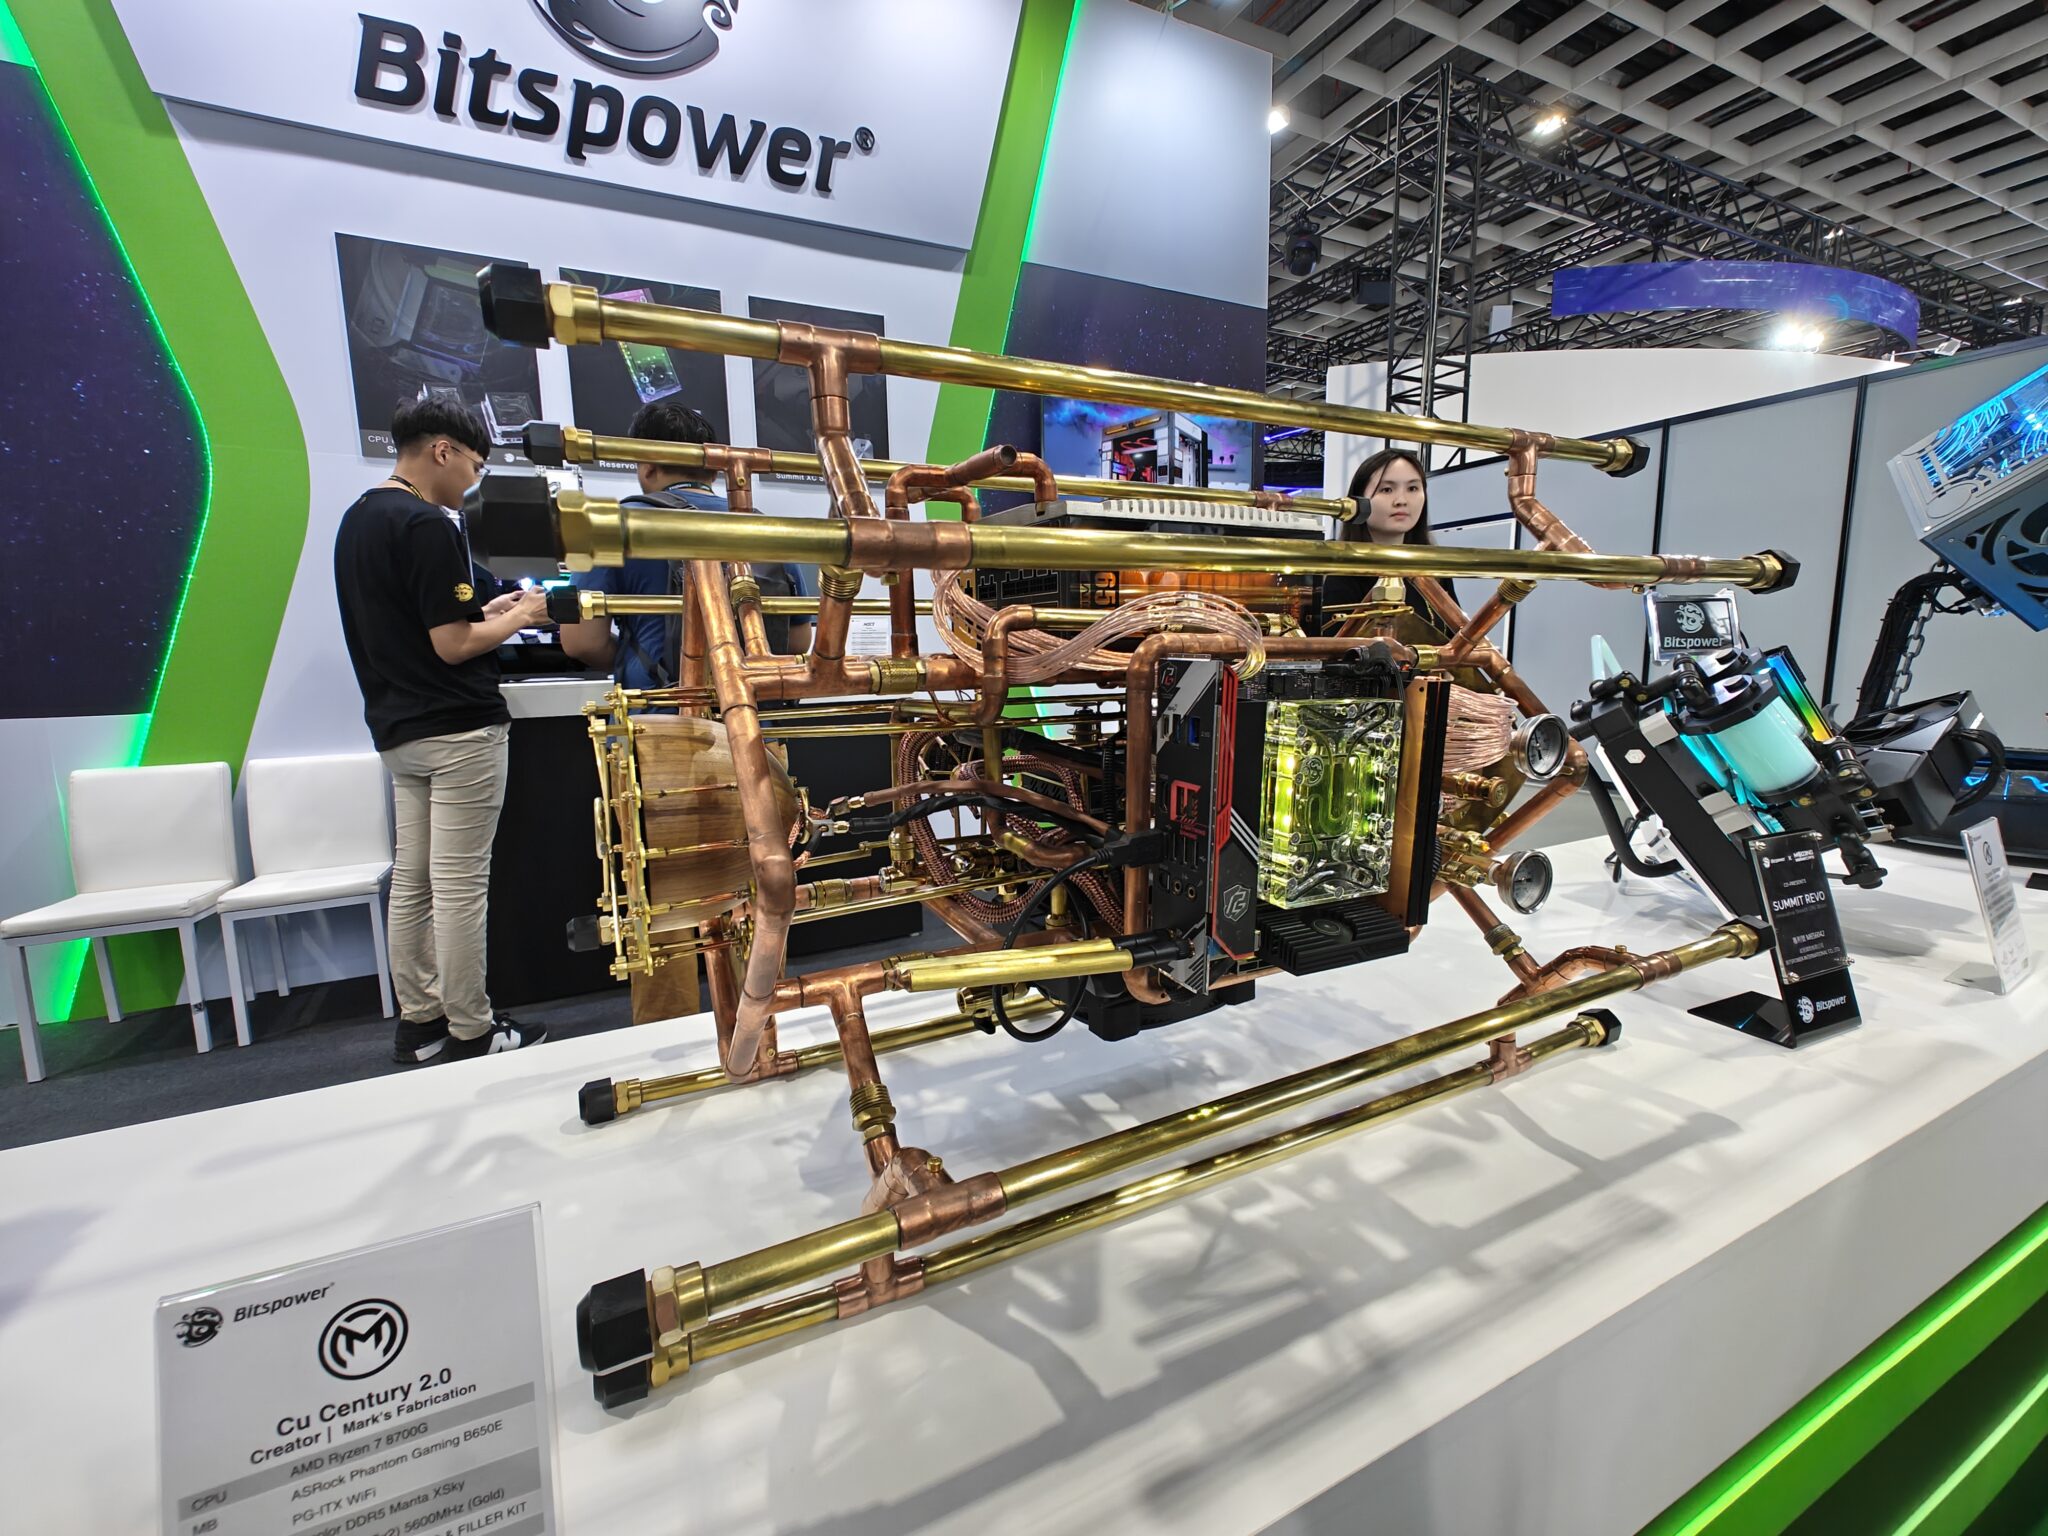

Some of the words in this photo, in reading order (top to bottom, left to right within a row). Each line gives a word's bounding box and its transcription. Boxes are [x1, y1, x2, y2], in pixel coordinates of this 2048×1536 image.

[368, 435, 389, 444] CPU
[1663, 636, 1723, 650] Bitspower
[1772, 895, 1804, 912] SUMMIT
[1804, 890, 1826, 905] REVO
[1815, 995, 1847, 1012] Bitspower
[233, 1285, 331, 1323] Bitspower
[276, 1414, 311, 1437] Cu
[319, 1382, 412, 1423] Century
[418, 1367, 452, 1392] 2.0
[250, 1432, 322, 1465] Creator
[342, 1411, 392, 1435] Mark's
[396, 1383, 477, 1417] Fabrication
[191, 1490, 228, 1513] CPU
[290, 1457, 325, 1478] AMD
[328, 1442, 371, 1468] Ryzen
[374, 1436, 383, 1450] 7
[386, 1422, 429, 1446] 8700G
[192, 1518, 219, 1536] MB
[291, 1474, 346, 1502] ASRock
[350, 1453, 408, 1482] Phantom
[411, 1436, 461, 1460] Gaming
[463, 1418, 504, 1442] B650E
[292, 1498, 343, 1527] PG-ITX
[346, 1487, 377, 1507] WiFi
[345, 1507, 386, 1532] DDR5
[389, 1493, 430, 1515] Manta
[432, 1480, 466, 1499] XSky
[404, 1502, 465, 1533] 5600MHz
[467, 1487, 505, 1511] (Gold)
[457, 1512, 505, 1536] FILLER
[506, 1501, 528, 1519] KIT
